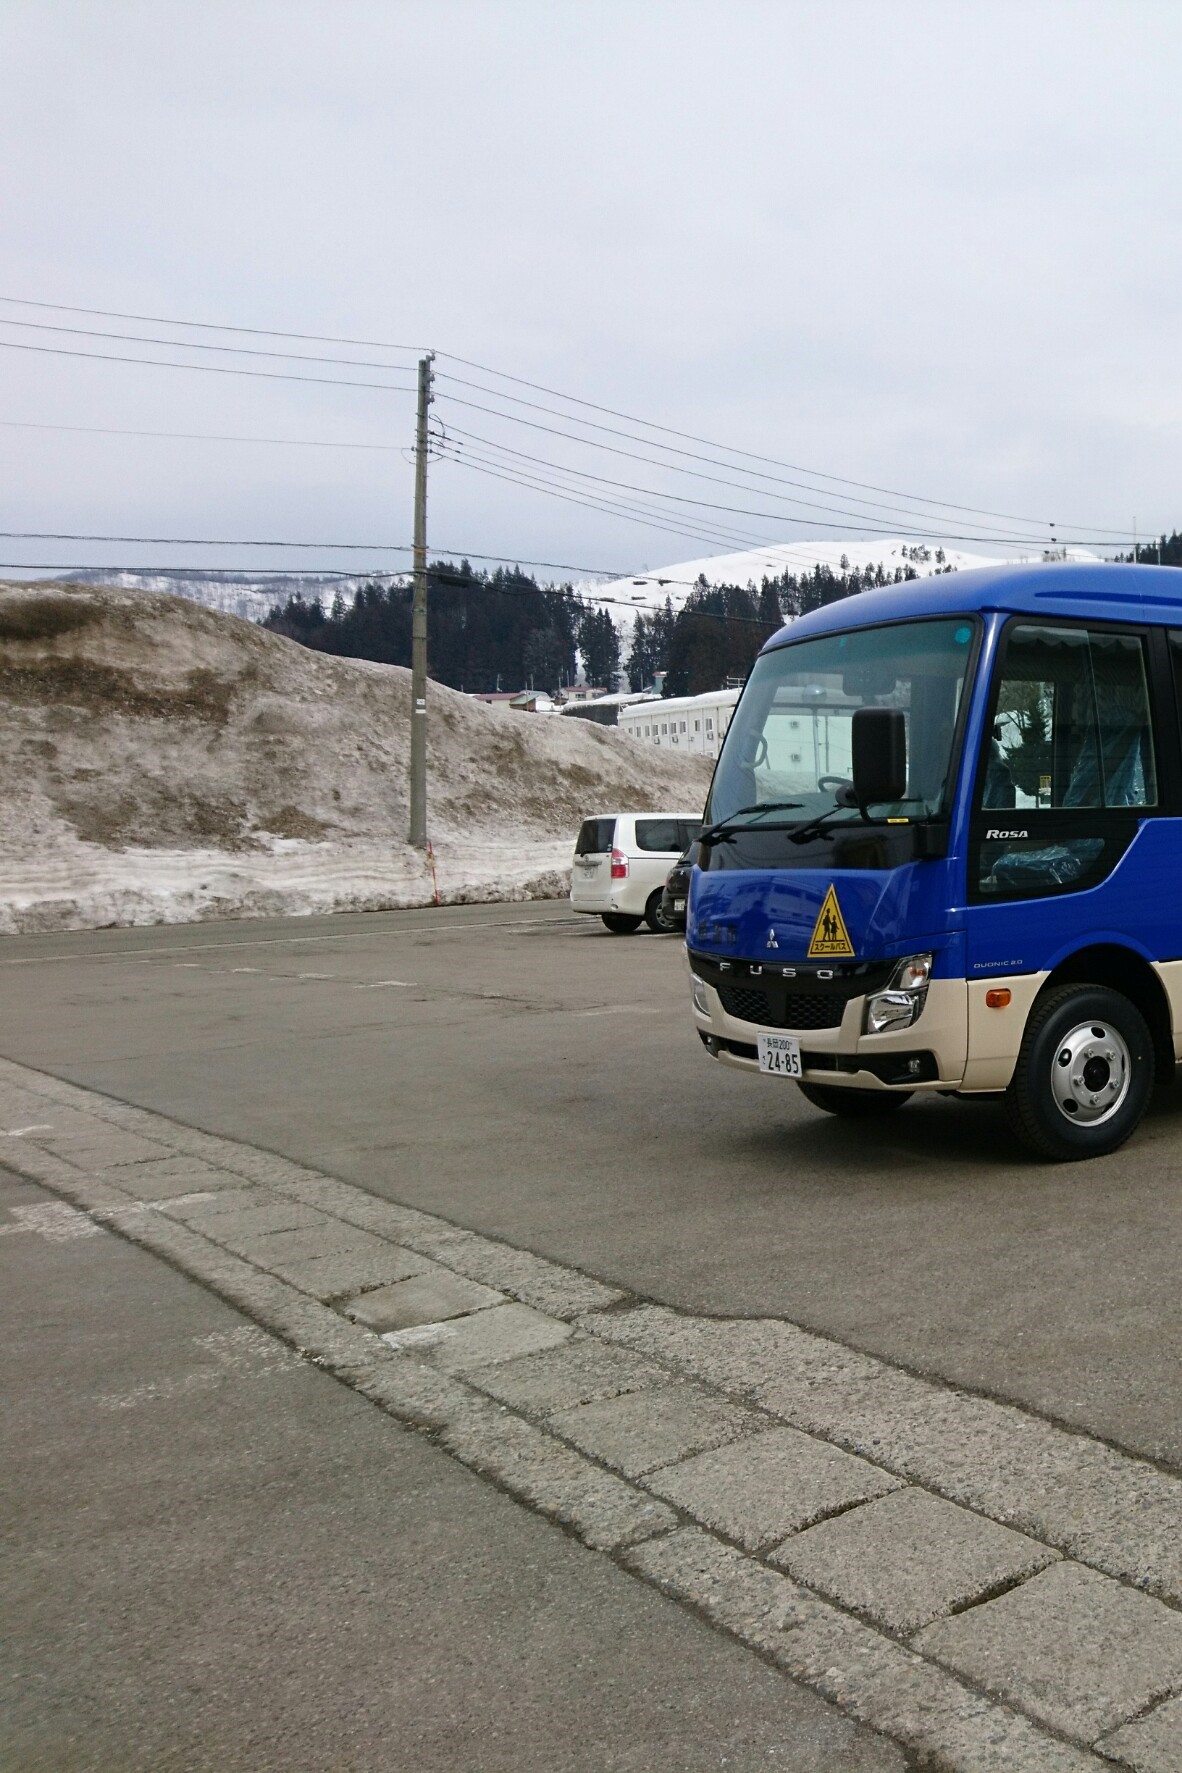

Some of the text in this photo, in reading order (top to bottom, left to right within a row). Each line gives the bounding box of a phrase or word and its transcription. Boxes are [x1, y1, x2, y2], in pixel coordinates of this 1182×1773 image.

[815, 943, 846, 951] スクールバス
[719, 962, 834, 980] FUSO
[973, 960, 1009, 969] DUONIC
[767, 1051, 799, 1074] 24-85
